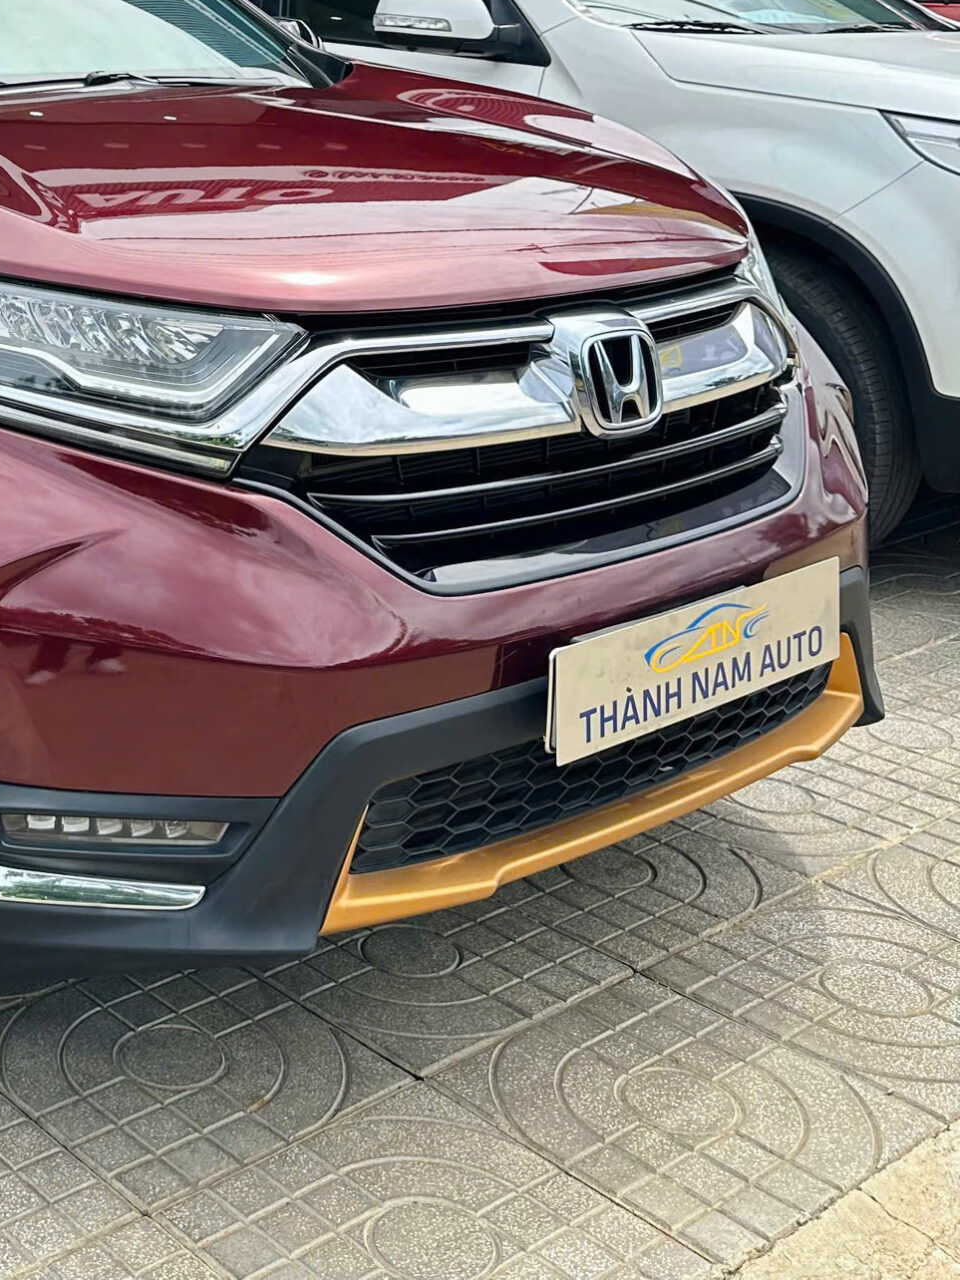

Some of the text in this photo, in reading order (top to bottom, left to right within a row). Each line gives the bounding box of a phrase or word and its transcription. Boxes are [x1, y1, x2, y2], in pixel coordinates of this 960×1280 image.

[579, 625, 823, 744] THÀNH NAM AUTO
